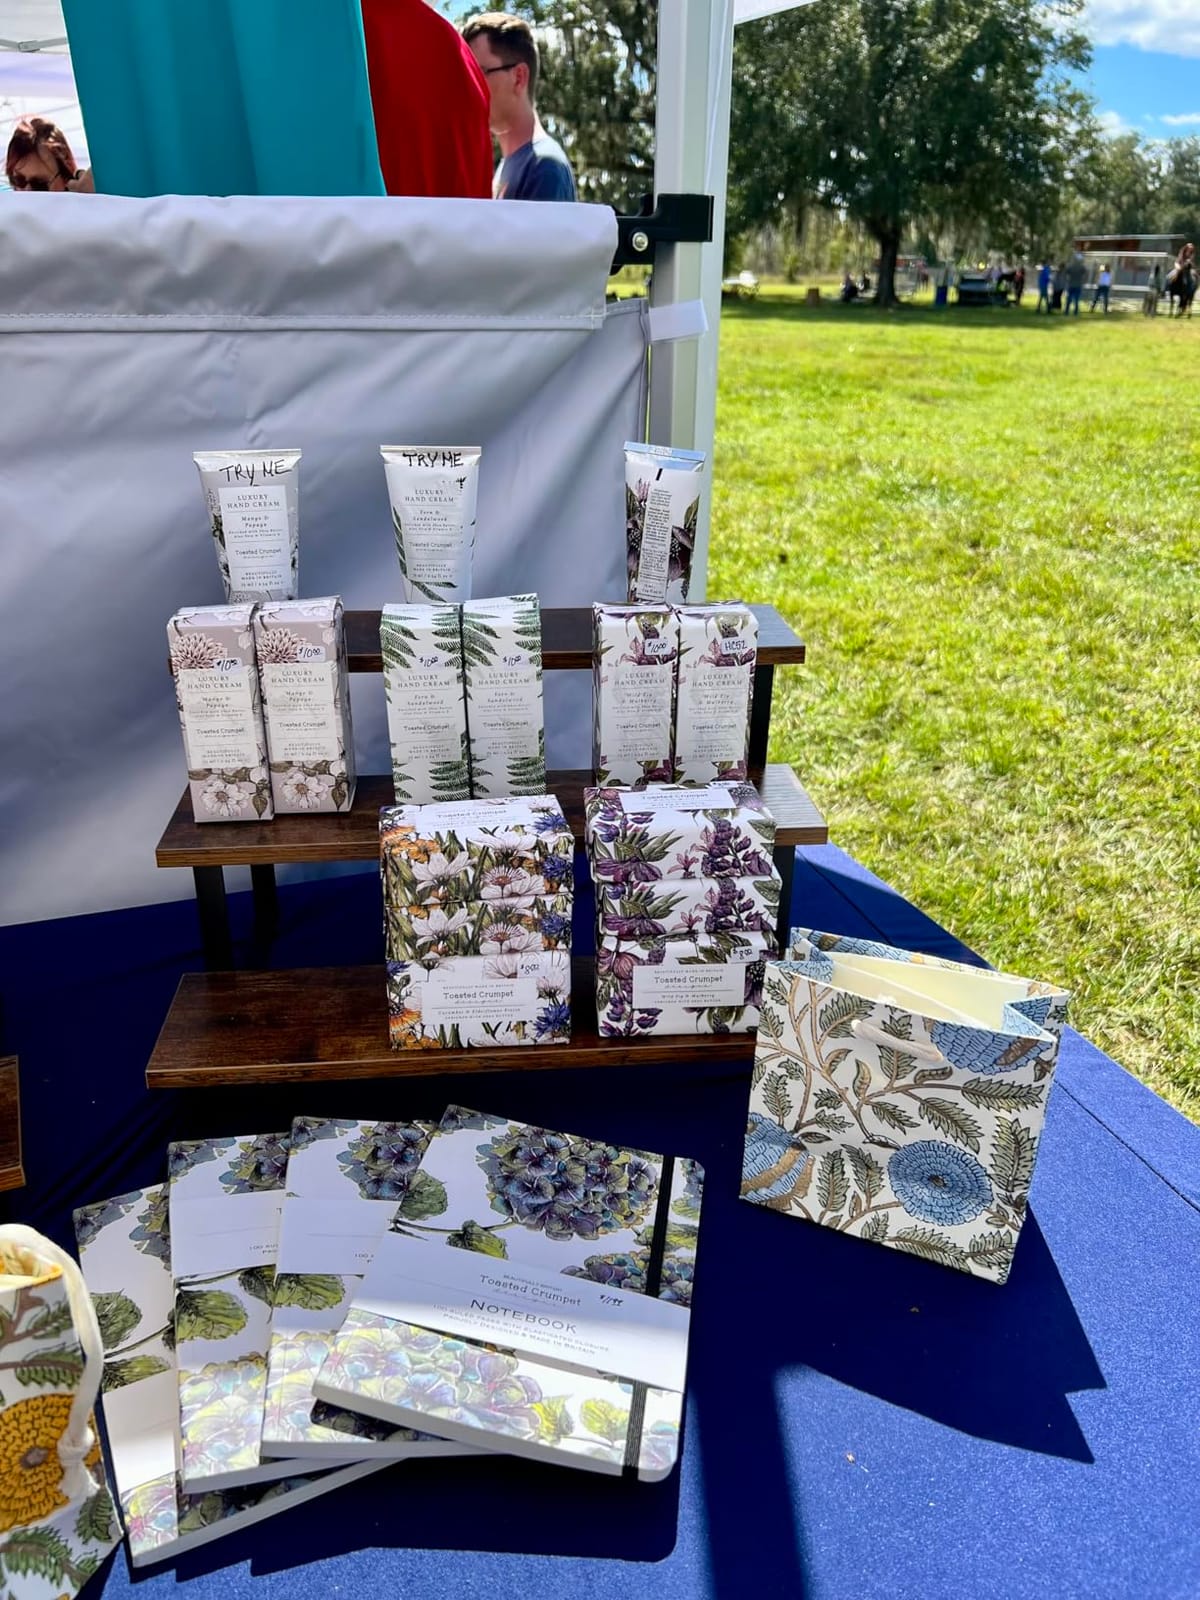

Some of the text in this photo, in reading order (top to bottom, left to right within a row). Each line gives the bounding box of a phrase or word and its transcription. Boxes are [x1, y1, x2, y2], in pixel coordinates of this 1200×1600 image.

[402, 452, 464, 468] TRY ME
[219, 459, 292, 486] TRY ME
[654, 976, 722, 984] Toasted Crumpet
[479, 990, 514, 998] Crumpet
[480, 1274, 528, 1293] Toasted
[531, 1287, 581, 1306] Crumpet
[470, 1299, 577, 1334] NOTEBOOK
